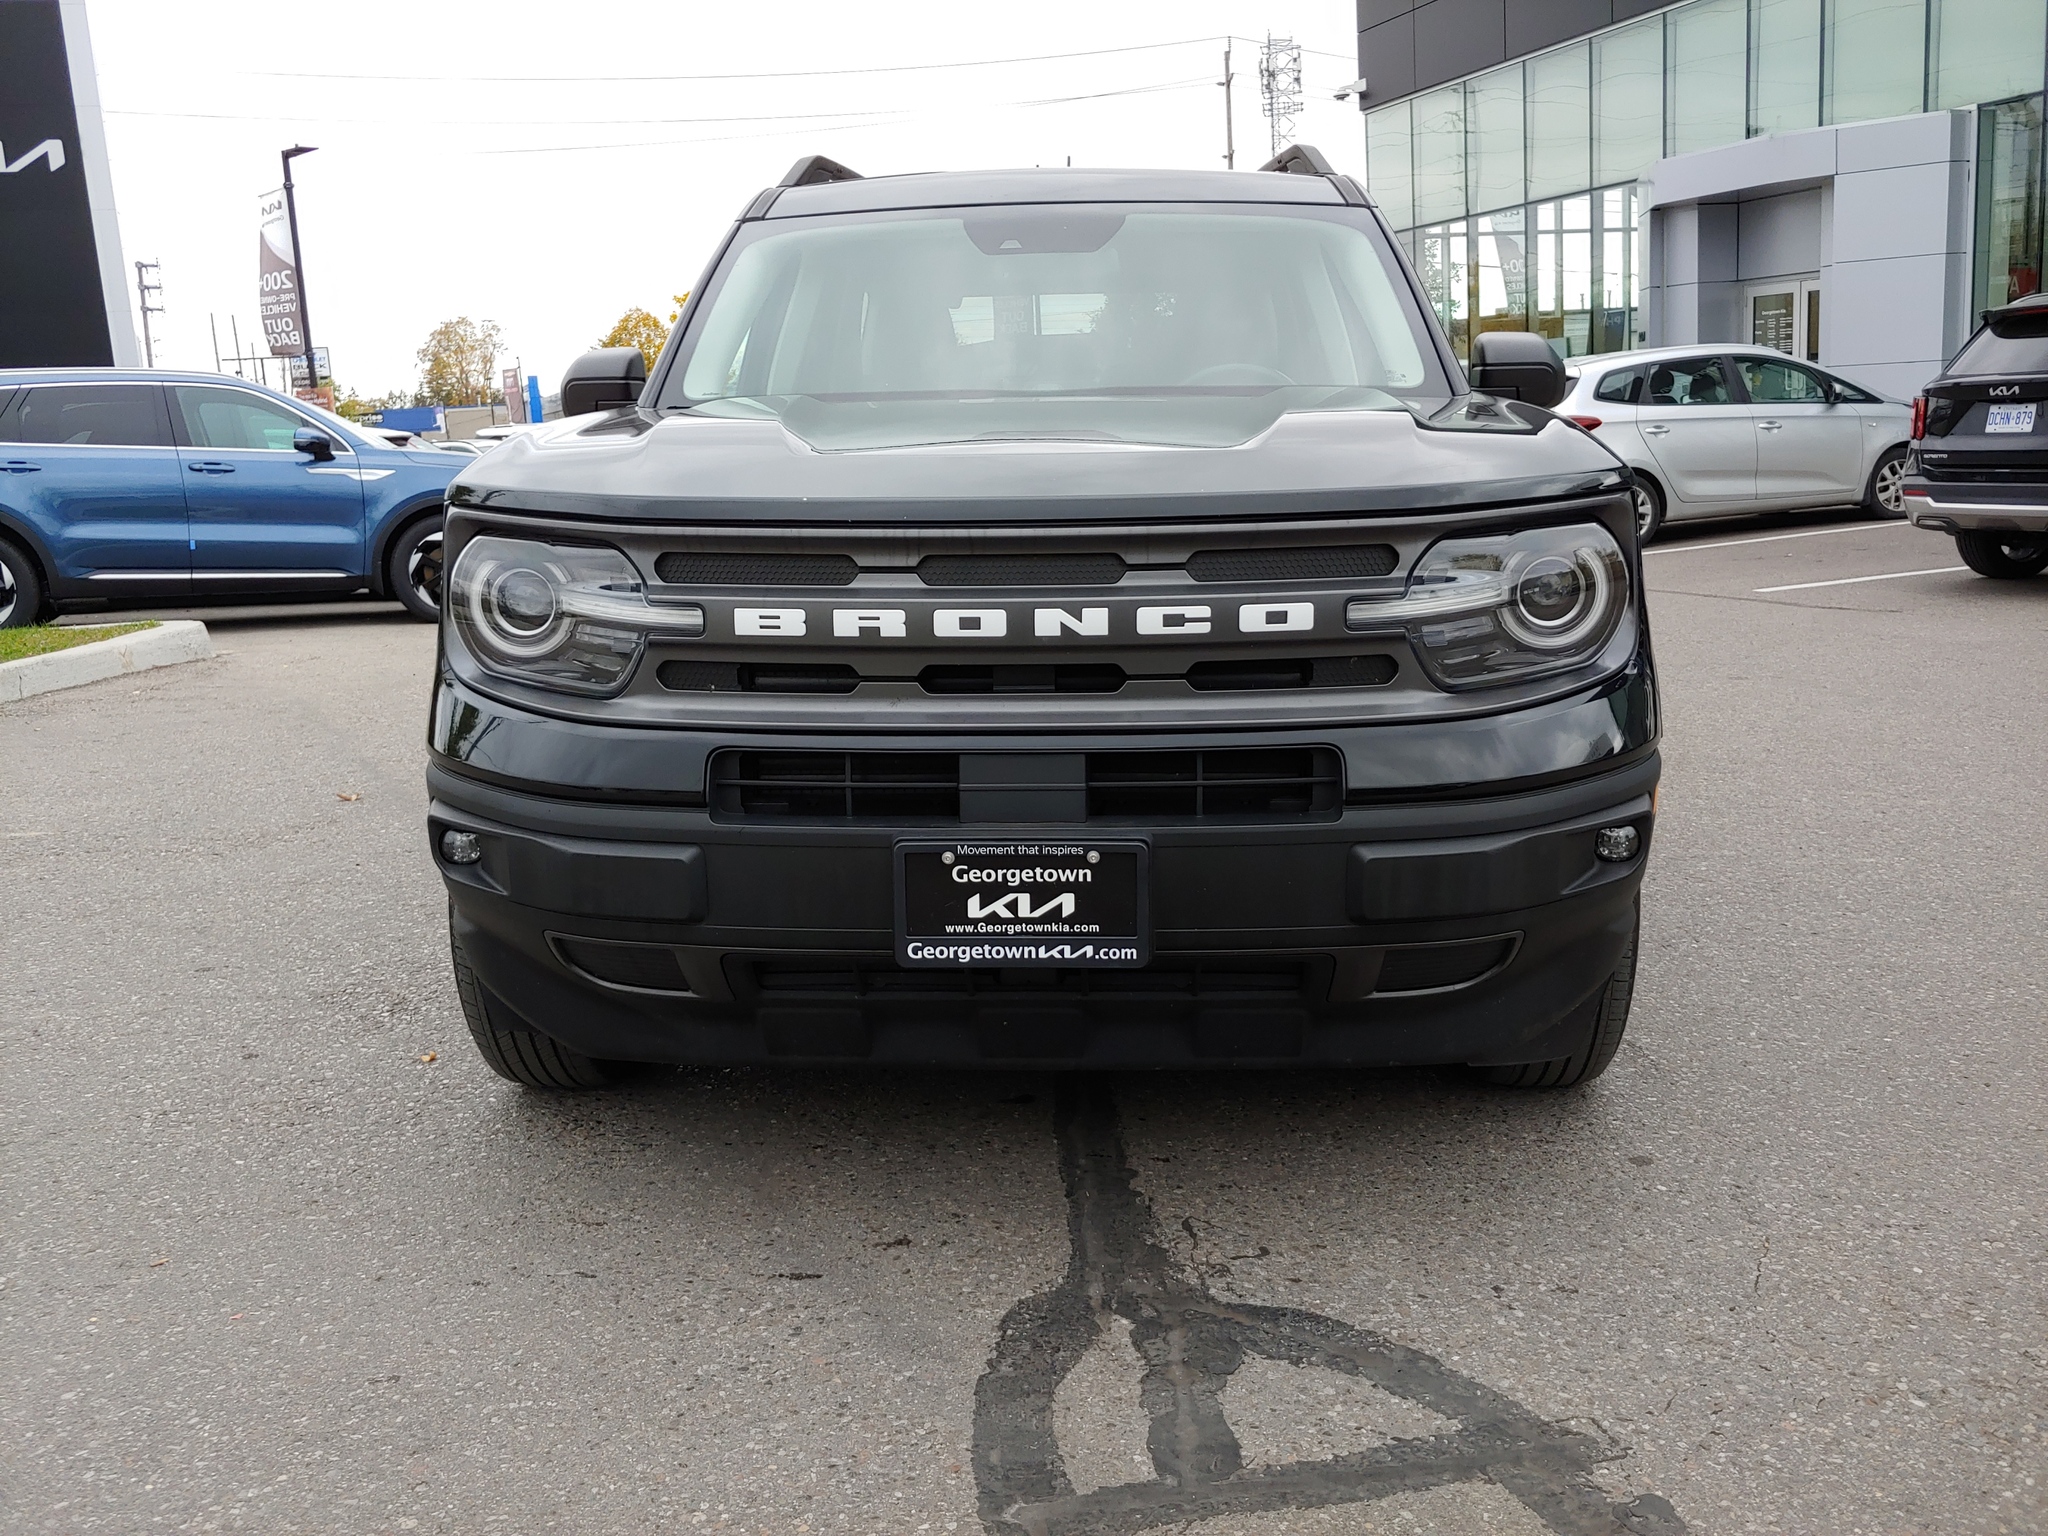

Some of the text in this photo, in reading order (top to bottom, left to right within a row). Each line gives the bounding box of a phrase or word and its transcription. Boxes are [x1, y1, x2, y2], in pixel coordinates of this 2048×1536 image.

[1989, 385, 2020, 396] KIA
[734, 602, 1315, 638] BRONCO
[957, 844, 1084, 857] Movement that inspires
[951, 865, 1092, 886] Georgetown
[967, 892, 1076, 918] KIA
[945, 922, 1100, 935] www.Georgetownkia.com
